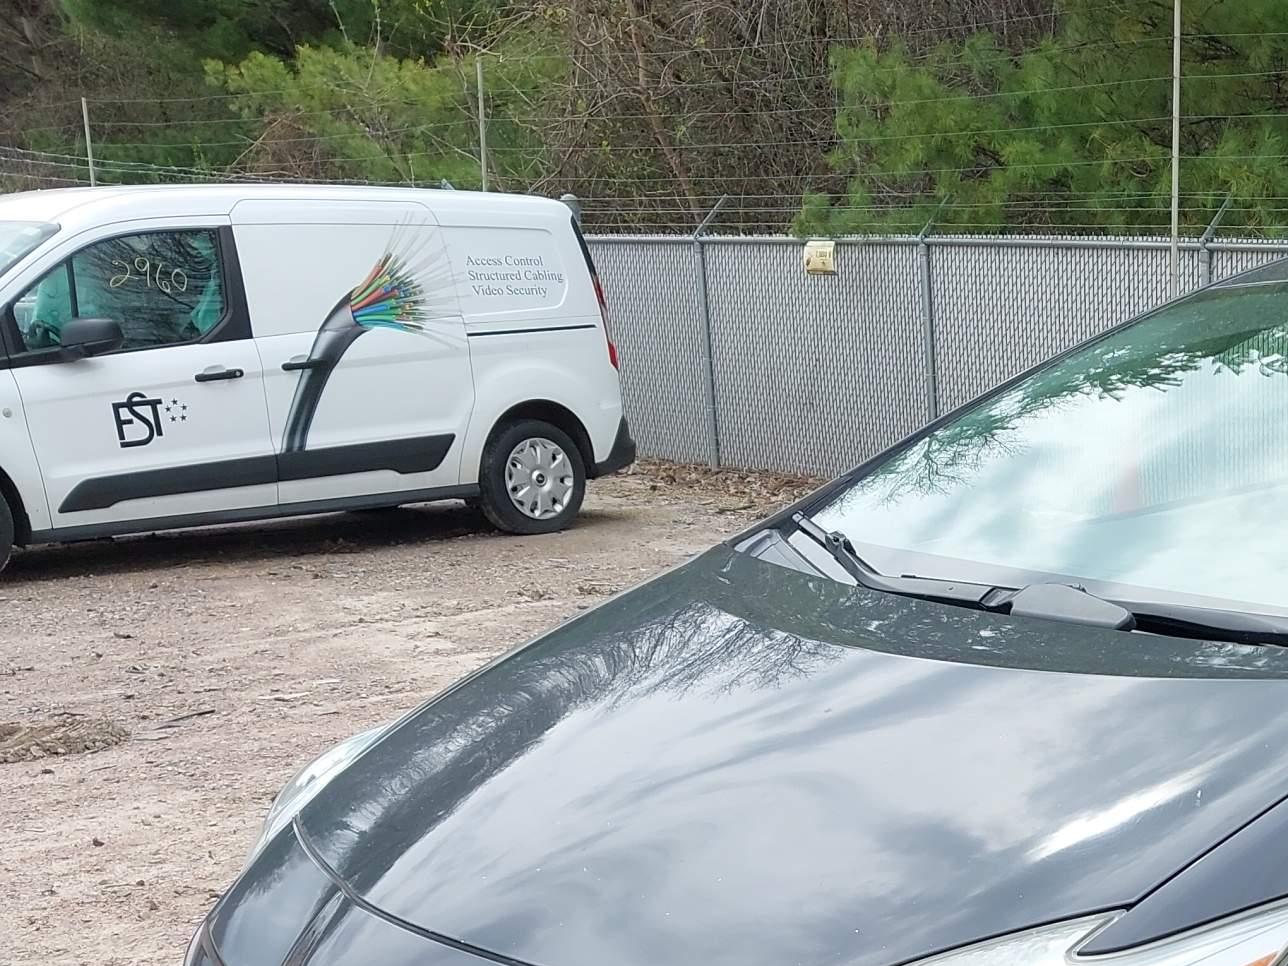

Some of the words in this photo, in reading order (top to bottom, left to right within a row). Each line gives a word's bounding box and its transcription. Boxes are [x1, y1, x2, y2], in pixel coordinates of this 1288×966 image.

[466, 255, 502, 266] Access
[505, 255, 544, 266] Control
[110, 257, 188, 295] 2960
[468, 270, 522, 281] Structured
[524, 270, 564, 283] Cabling
[472, 284, 504, 296] Video
[506, 284, 548, 298] Security
